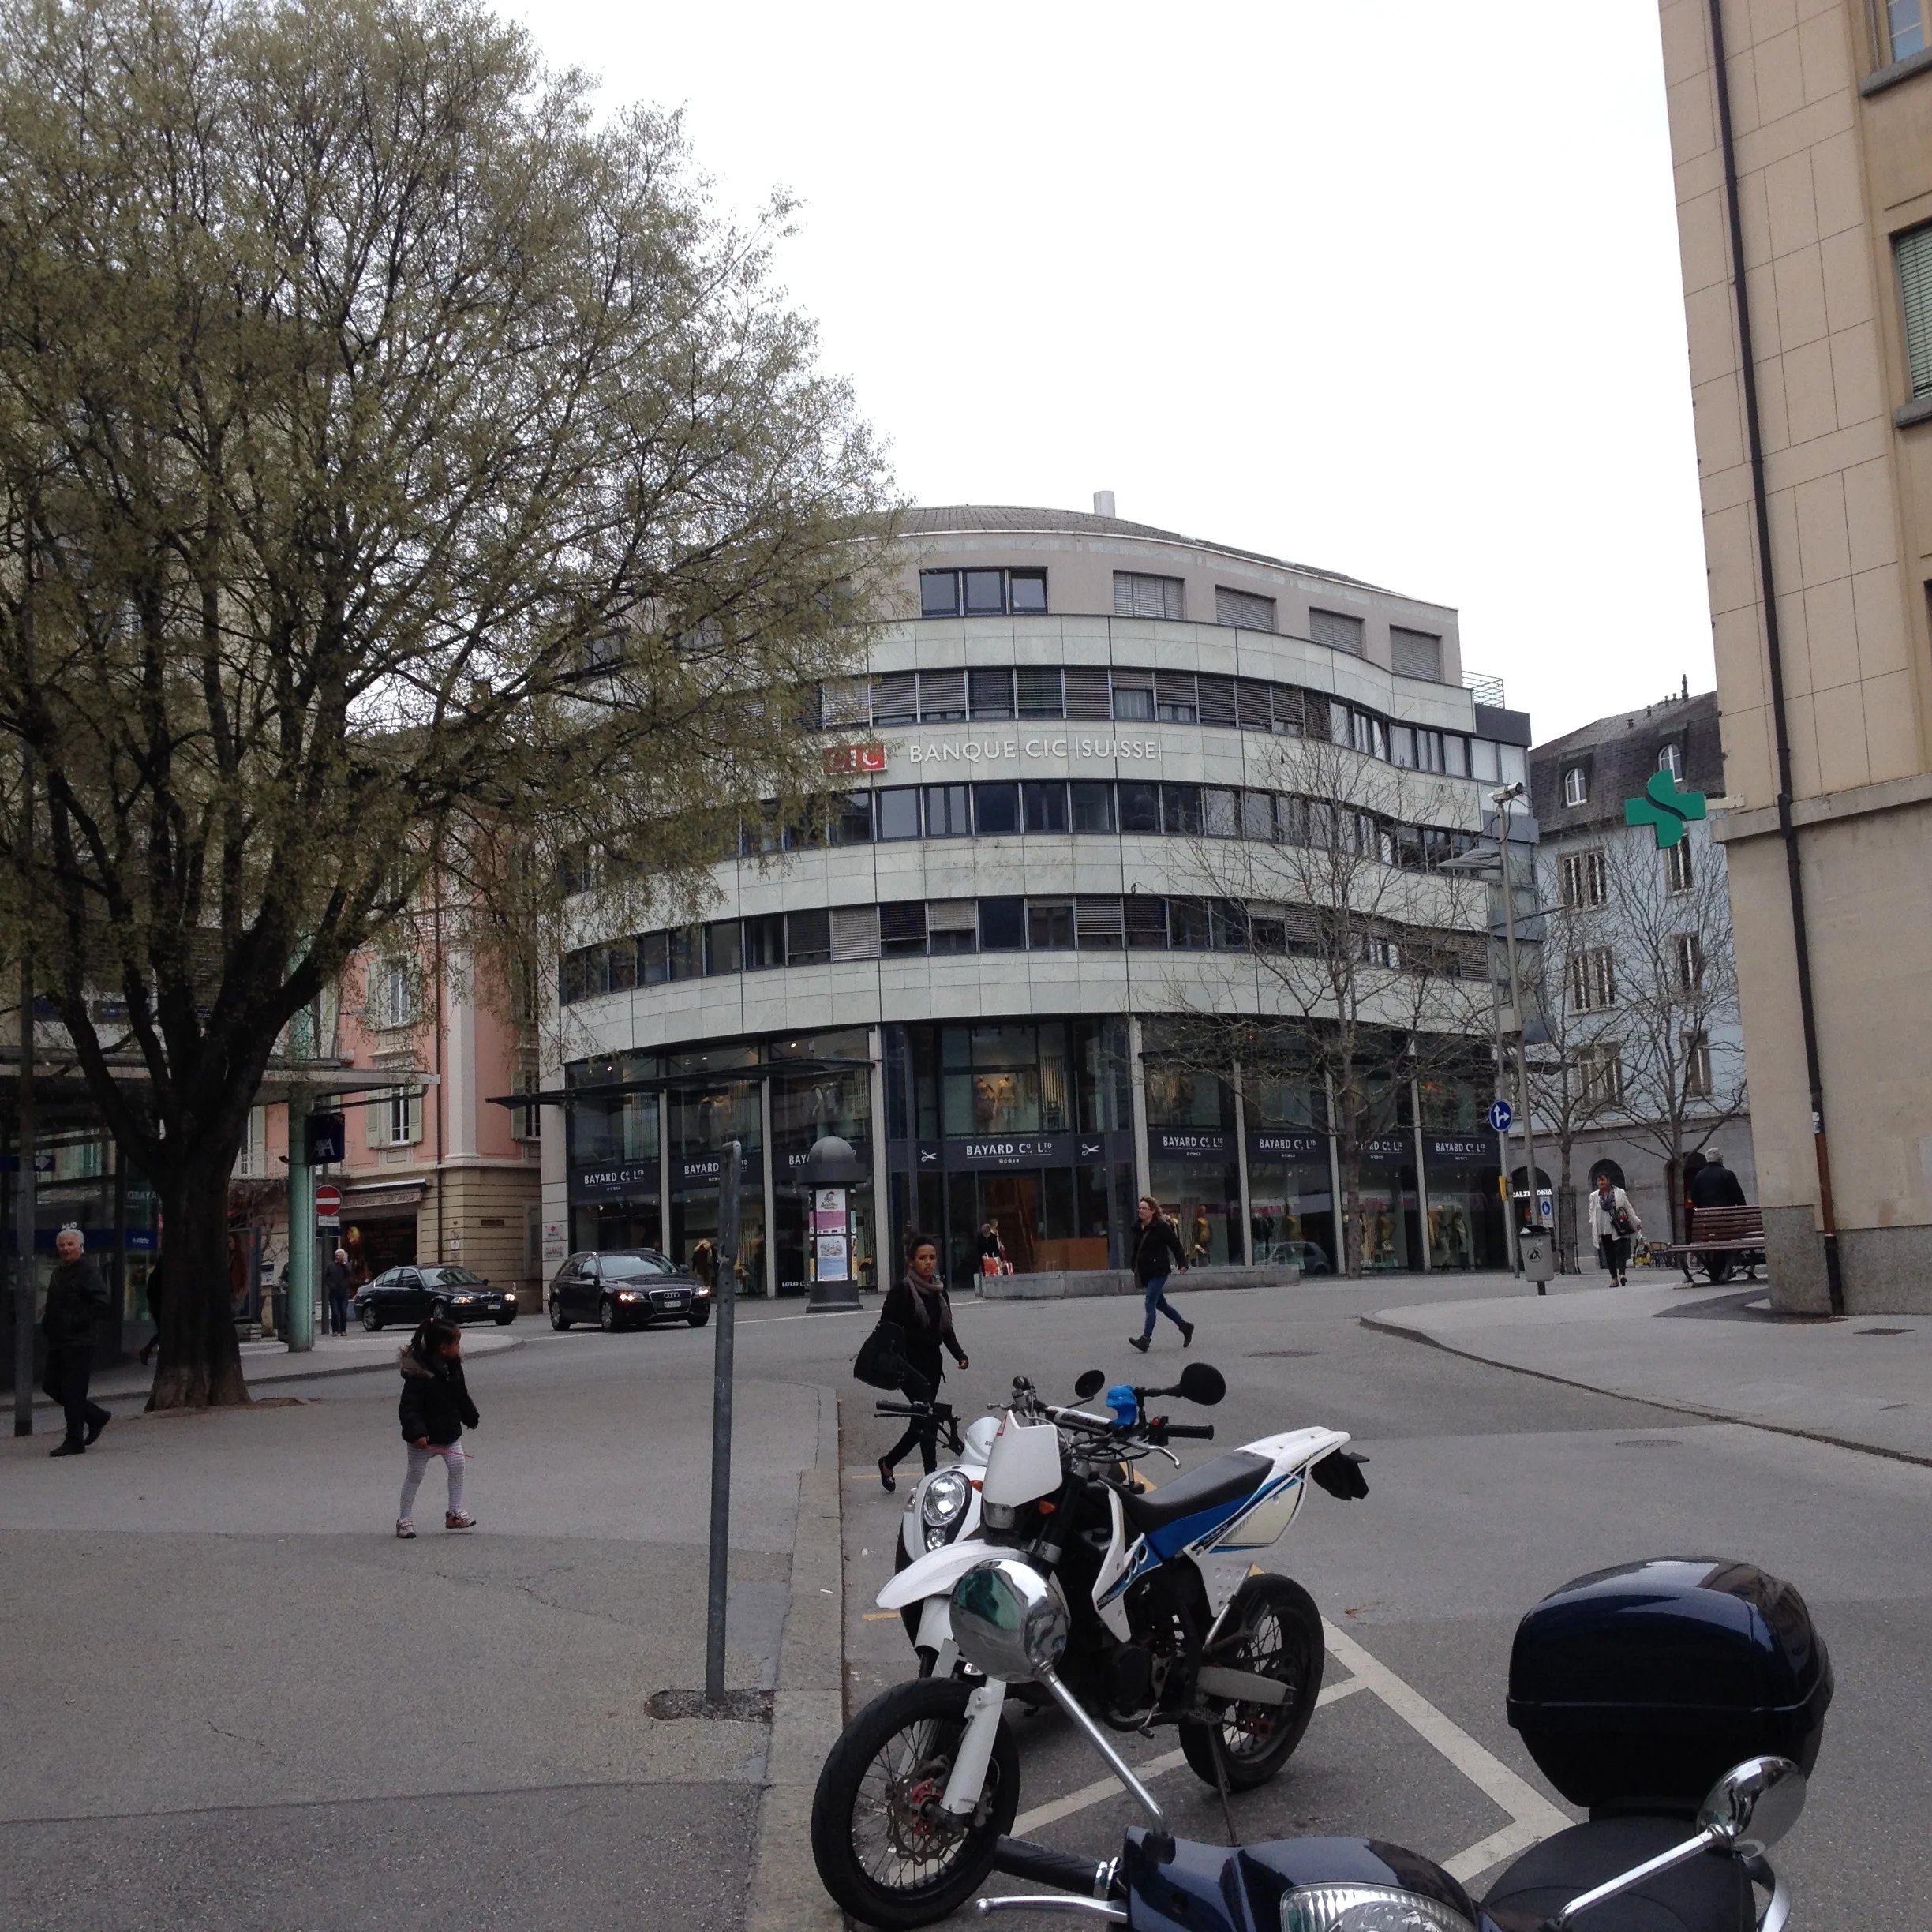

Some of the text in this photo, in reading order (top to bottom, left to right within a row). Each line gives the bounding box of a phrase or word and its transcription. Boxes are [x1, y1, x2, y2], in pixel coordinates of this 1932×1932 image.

[910, 739, 1155, 763] BANQUE CIC SUISSE
[828, 749, 878, 768] IC
[1163, 1136, 1197, 1147] BAYARD
[1259, 1139, 1291, 1149] BAYARD
[1436, 1142, 1463, 1152] BAYARD
[314, 1138, 335, 1158] AXA
[966, 1144, 1013, 1156] BAYARD
[788, 1154, 810, 1166] BAY
[684, 1162, 719, 1175] BAYARD
[584, 1173, 617, 1185] BAYARD
[1513, 1189, 1552, 1198] CALZONIA
